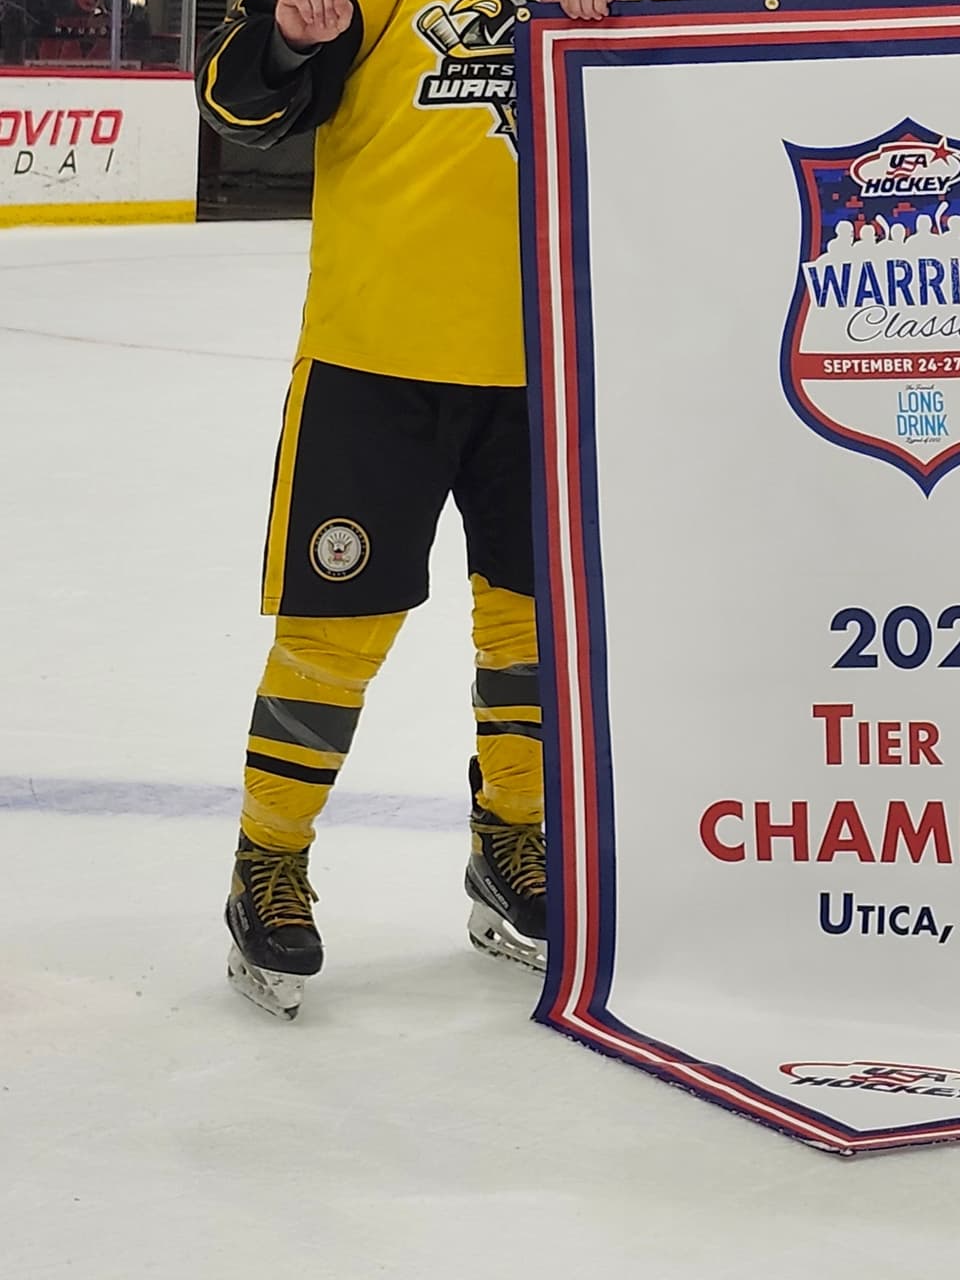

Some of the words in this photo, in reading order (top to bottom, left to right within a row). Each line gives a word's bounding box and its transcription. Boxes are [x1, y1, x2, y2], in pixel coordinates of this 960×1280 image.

[427, 79, 517, 98] WAR
[888, 153, 928, 170] USA
[864, 176, 951, 194] HOCKEY
[823, 358, 913, 373] SEPTEMBER
[898, 391, 944, 413] LONG
[896, 414, 949, 436] DRINK
